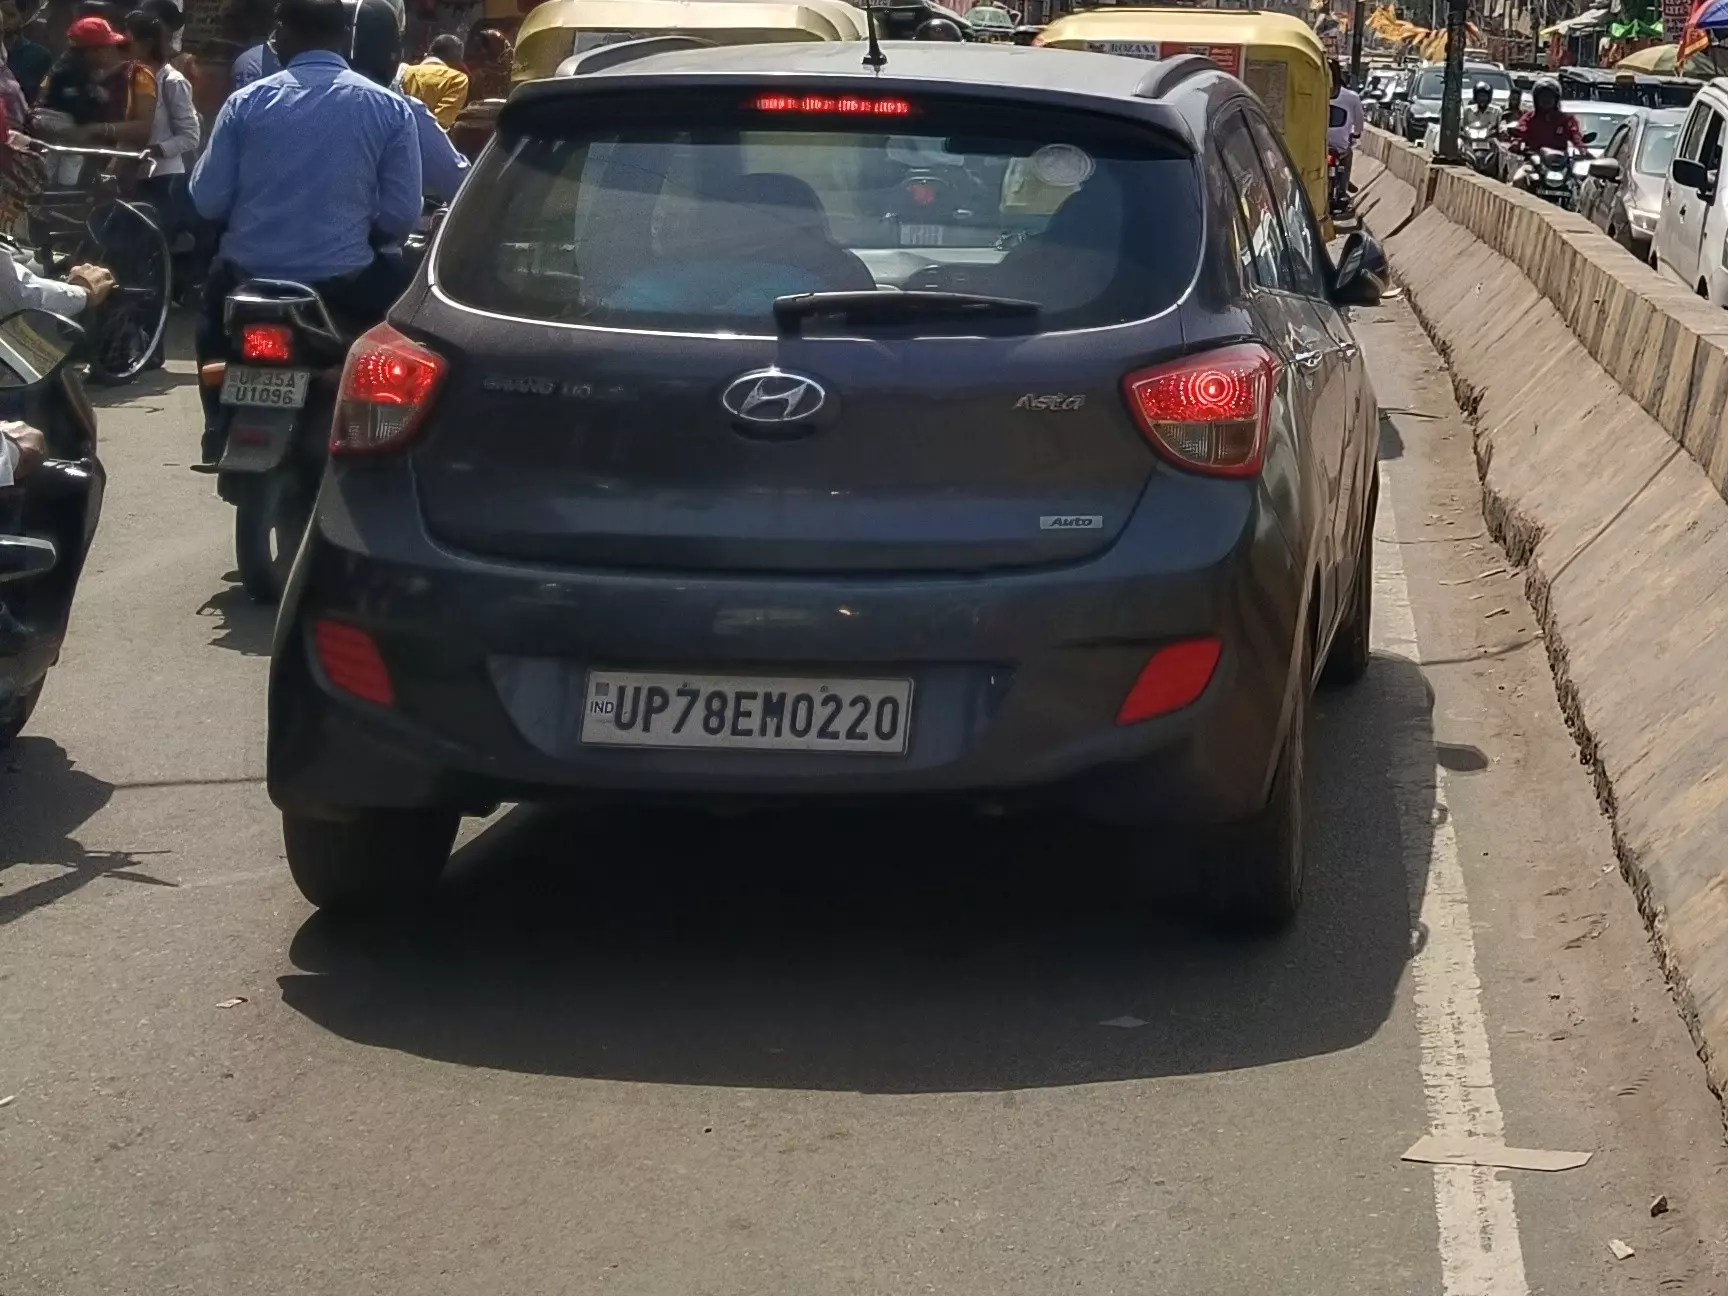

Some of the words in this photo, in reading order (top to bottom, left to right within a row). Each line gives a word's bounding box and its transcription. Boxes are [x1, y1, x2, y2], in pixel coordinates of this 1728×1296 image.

[1012, 392, 1087, 413] Asta
[1049, 516, 1093, 528] Auto
[589, 700, 614, 716] IND
[613, 682, 900, 744] UP78EM0220
